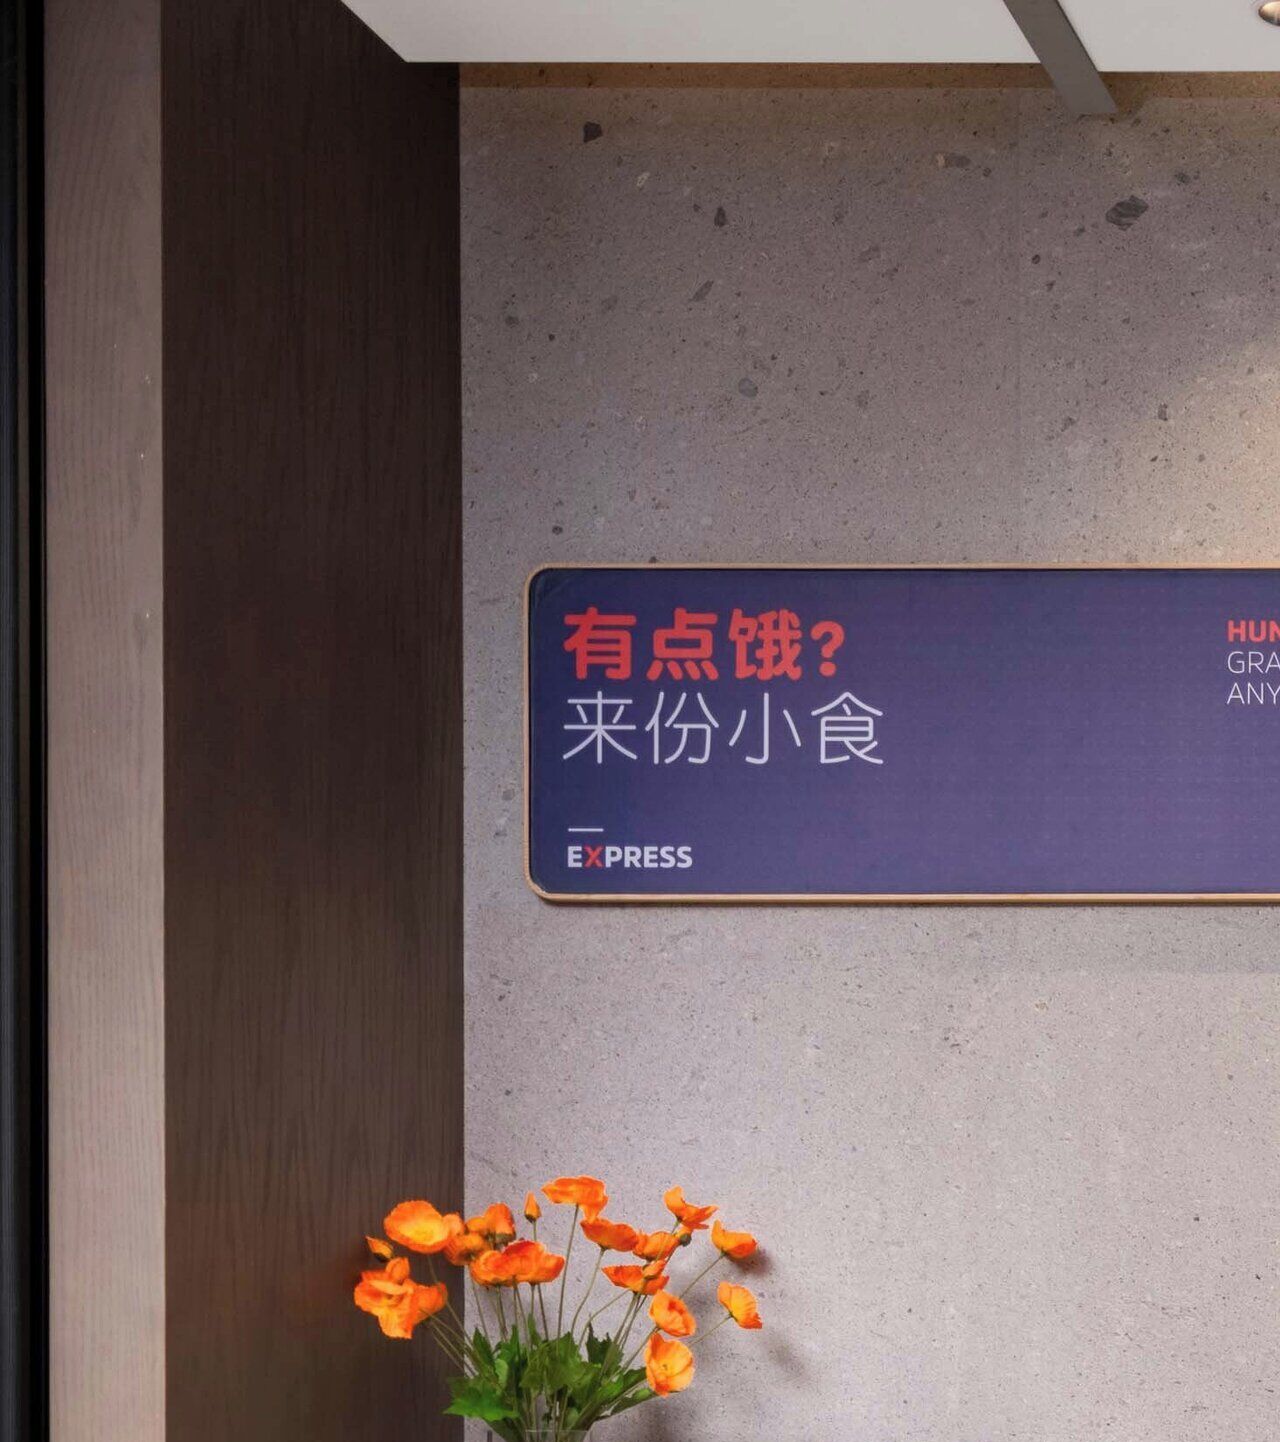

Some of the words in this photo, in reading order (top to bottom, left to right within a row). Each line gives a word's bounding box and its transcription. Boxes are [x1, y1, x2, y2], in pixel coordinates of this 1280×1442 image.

[562, 606, 846, 681] 有点饿?
[562, 690, 884, 765] 来份小食
[567, 845, 693, 869] EXPRESS
